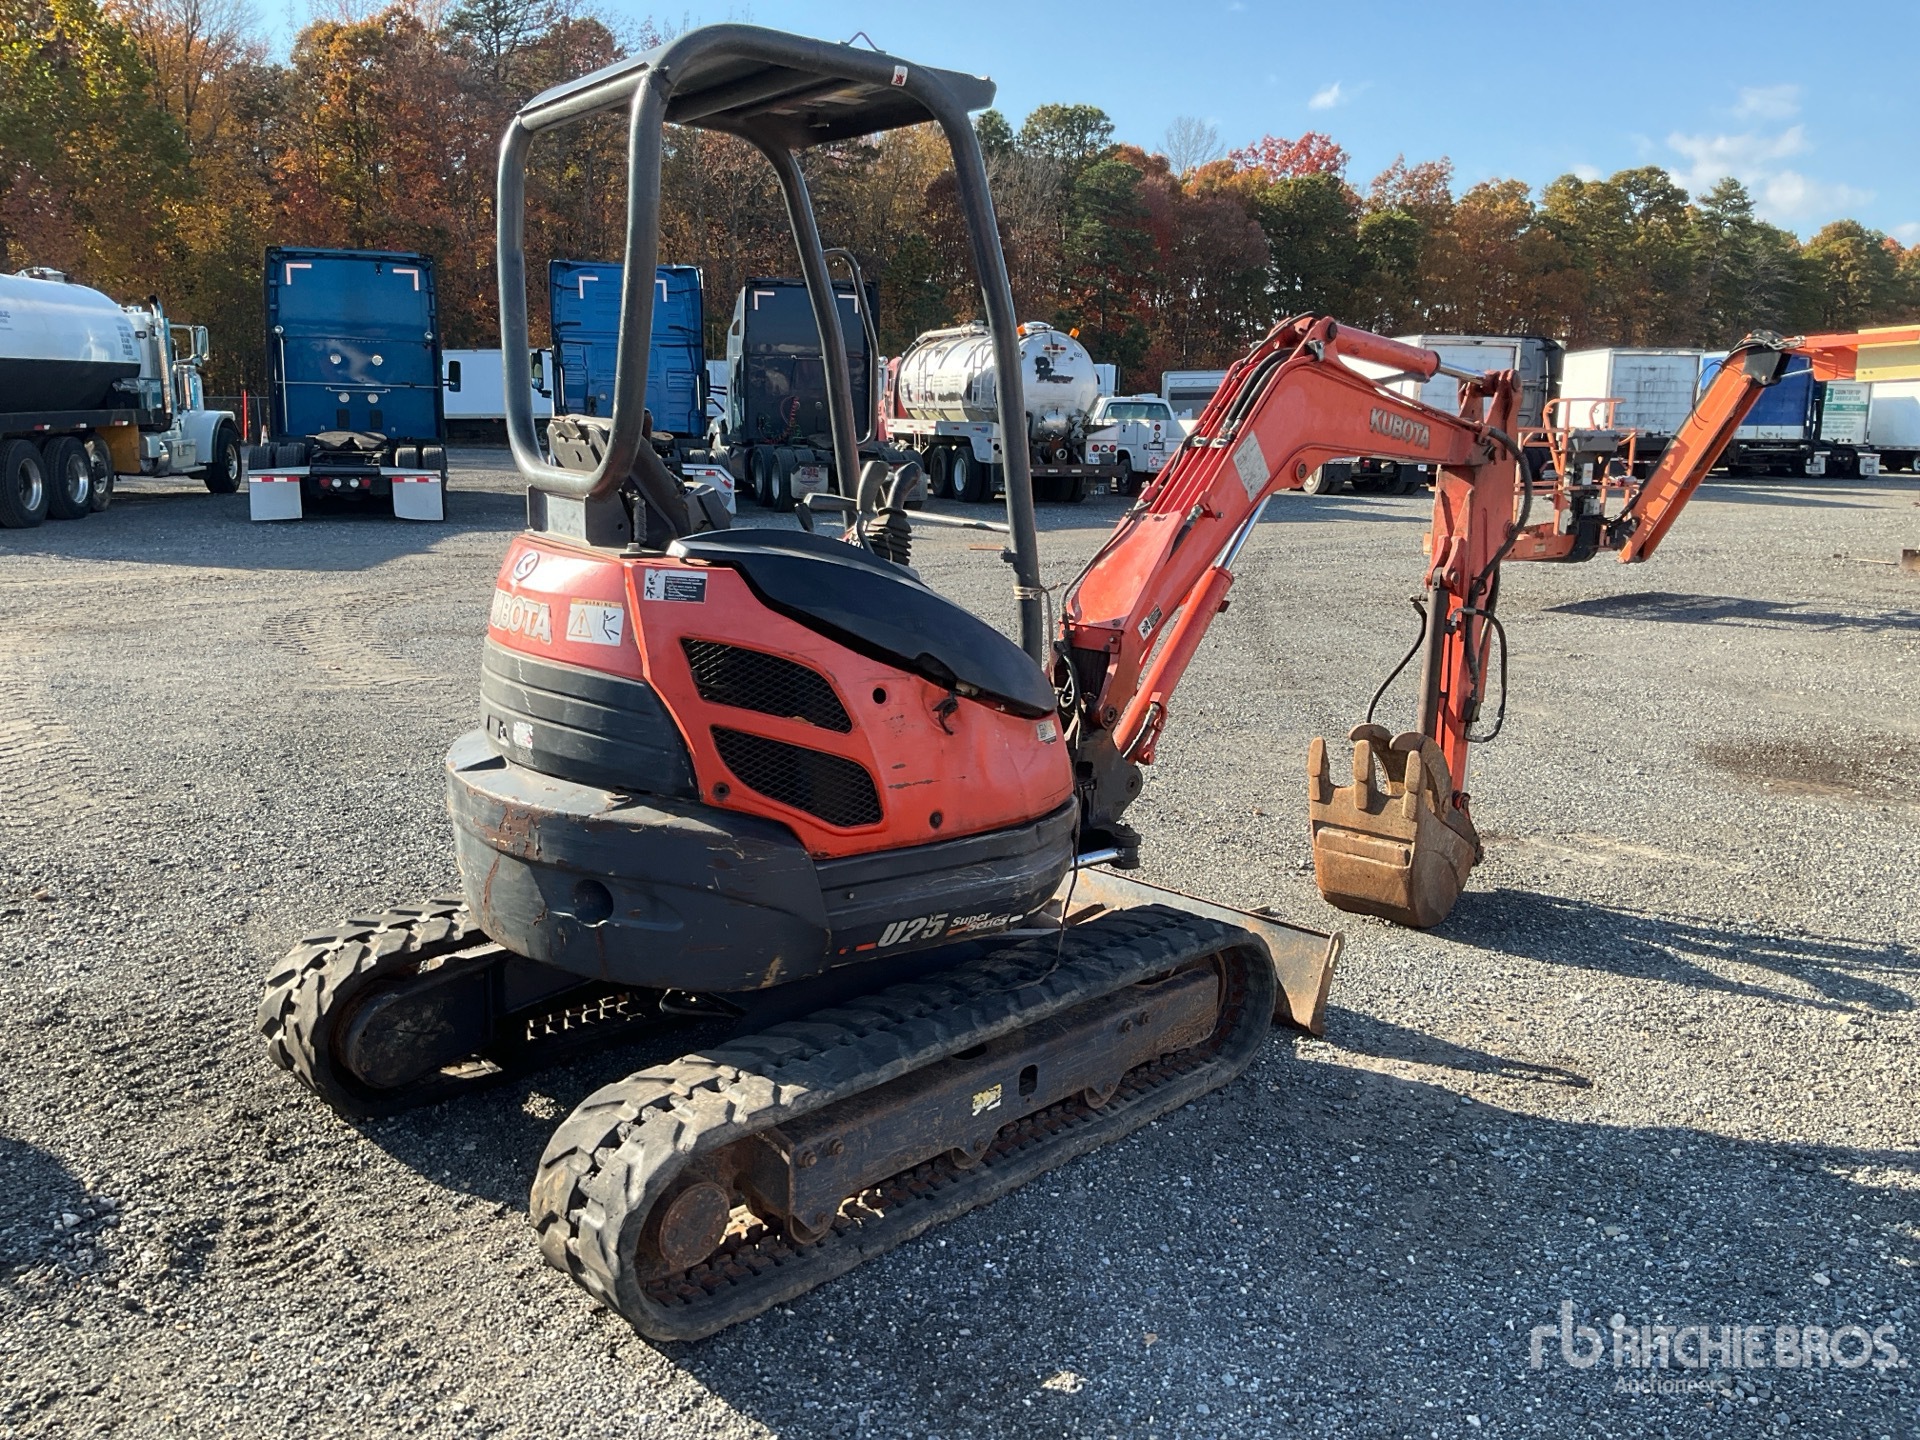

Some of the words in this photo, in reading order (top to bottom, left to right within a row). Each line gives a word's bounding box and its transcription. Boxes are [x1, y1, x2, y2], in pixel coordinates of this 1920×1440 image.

[1370, 407, 1430, 449] KUBOTA
[585, 600, 613, 608] WARNING
[877, 913, 949, 948] U25
[950, 912, 991, 927] Super
